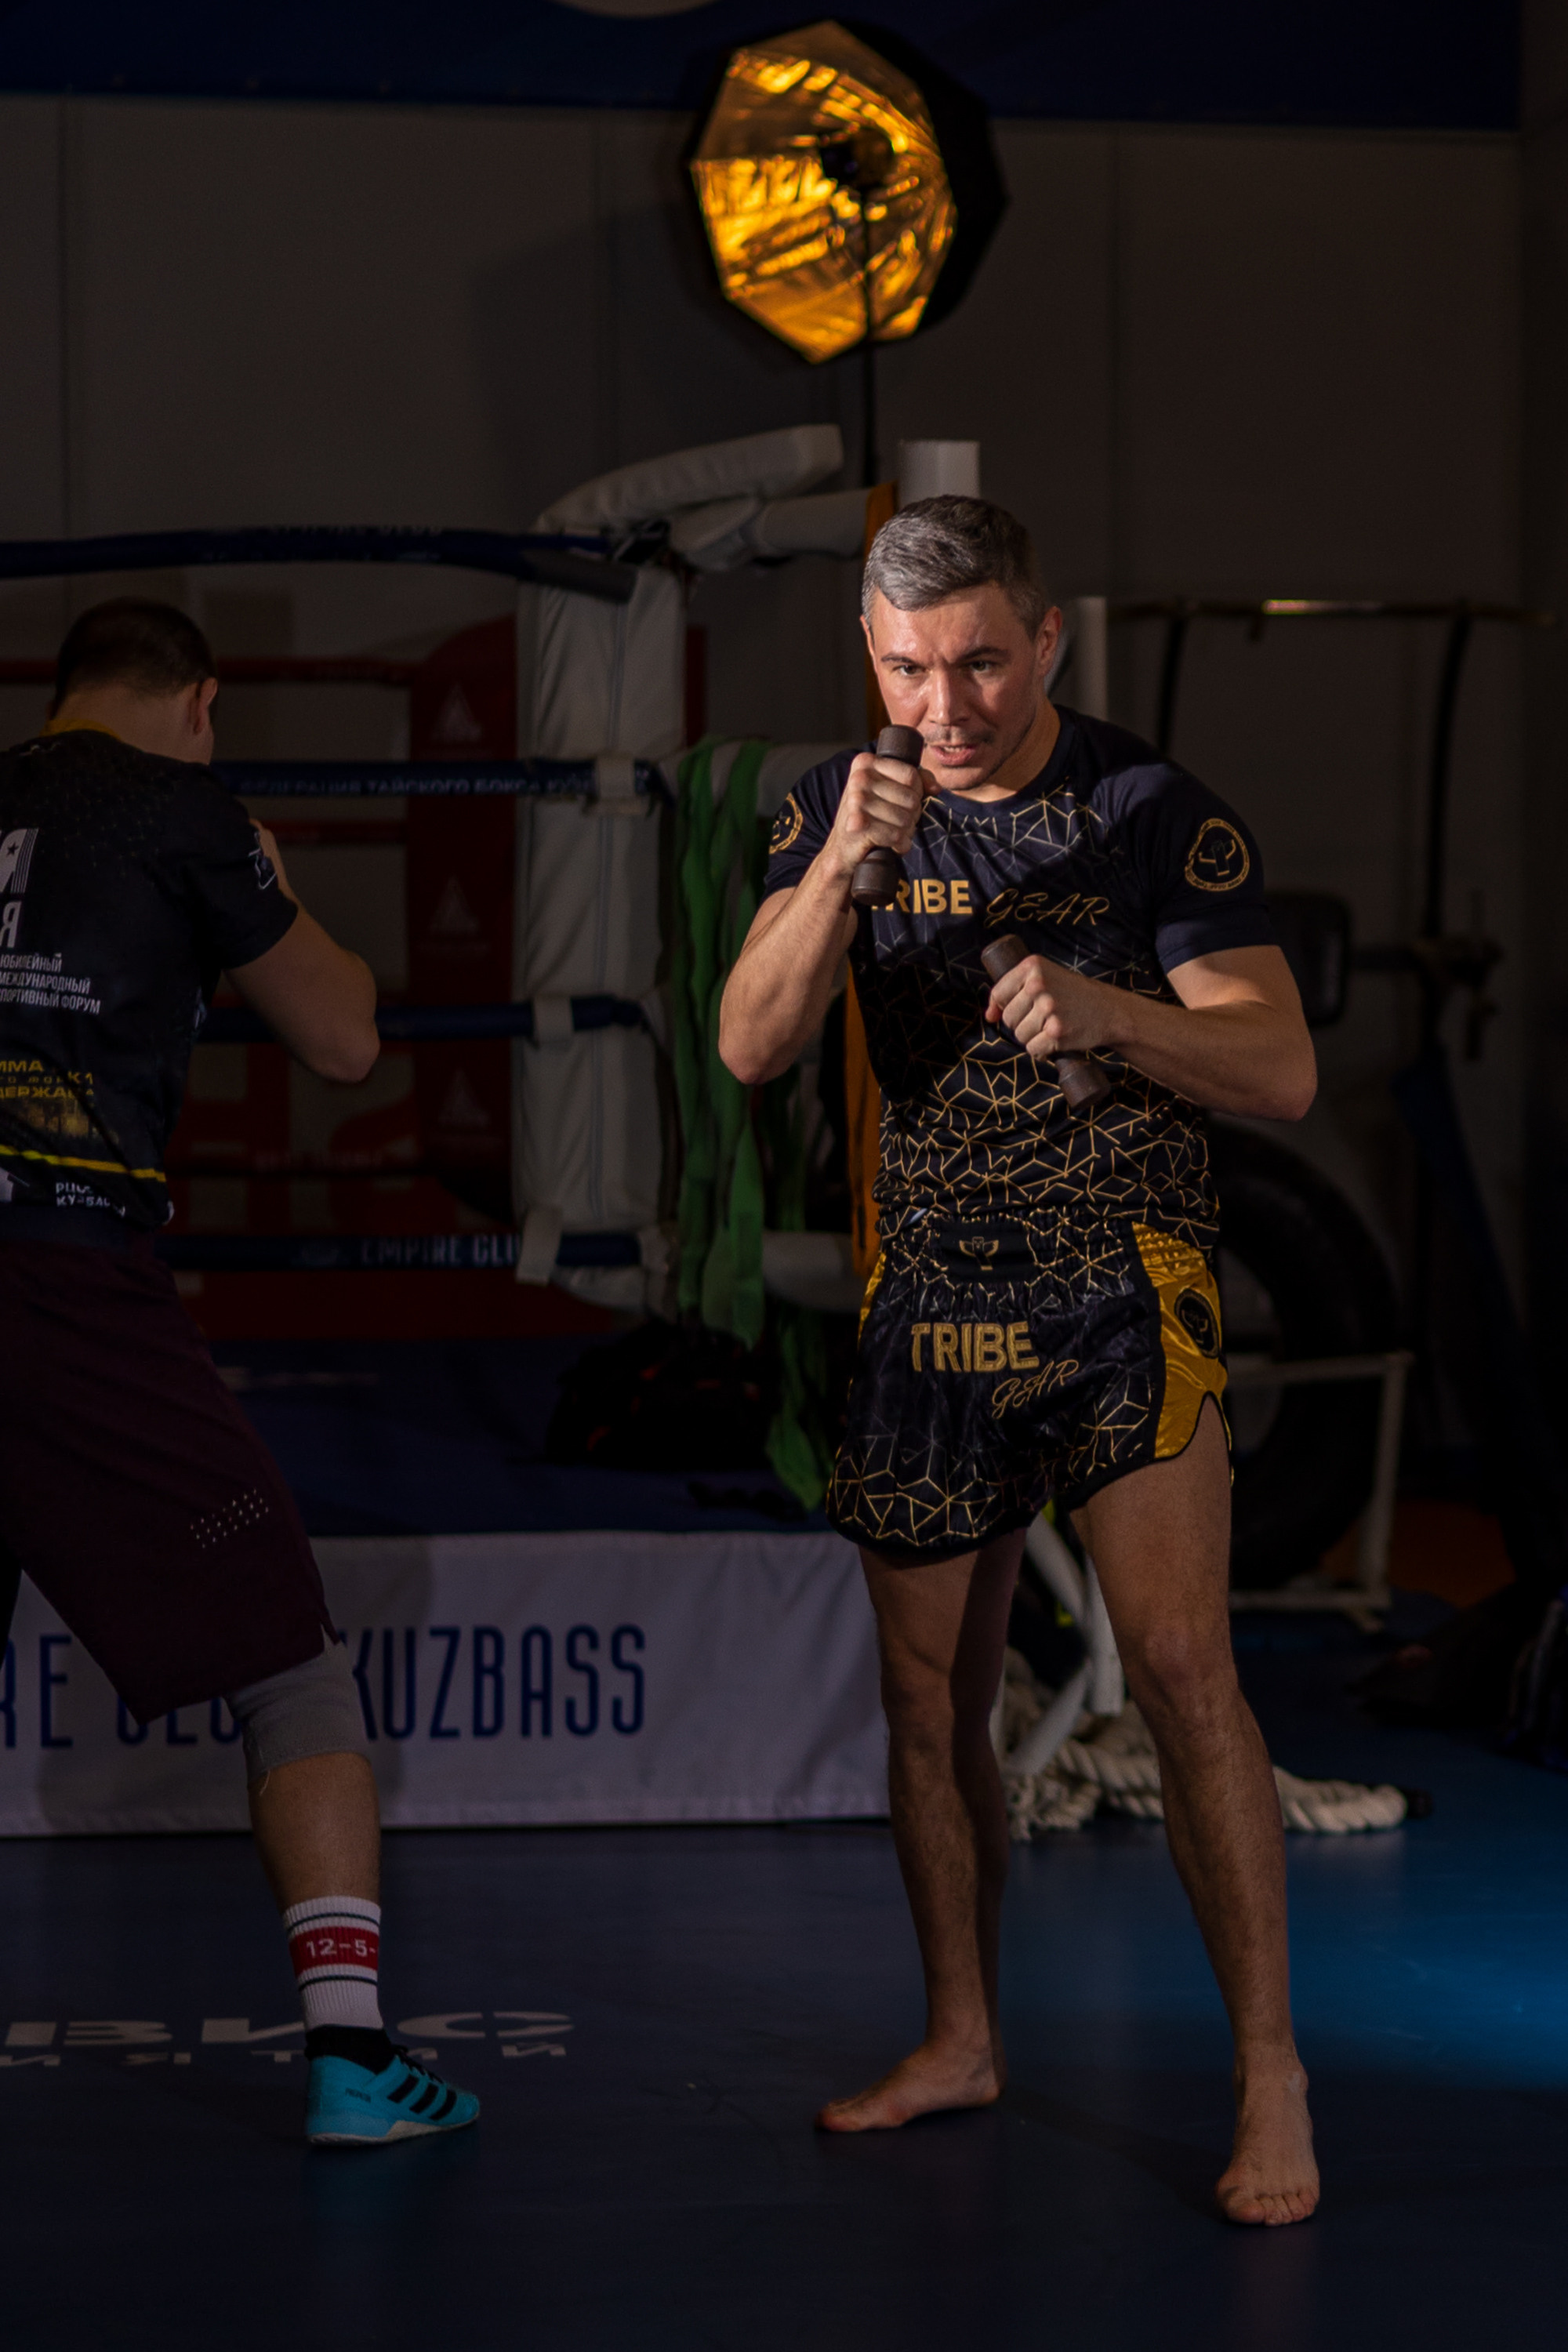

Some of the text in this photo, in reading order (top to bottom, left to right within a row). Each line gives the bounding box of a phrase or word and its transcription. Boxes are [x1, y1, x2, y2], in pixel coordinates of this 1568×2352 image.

[870, 878, 1110, 929] RIBE GEAR
[0, 988, 101, 1016] ПОРТИВНЫЙ ФОРУМ
[910, 1320, 1040, 1373] TRIBE
[990, 1358, 1080, 1420] GEAR
[337, 1624, 645, 1740] KUZBASS
